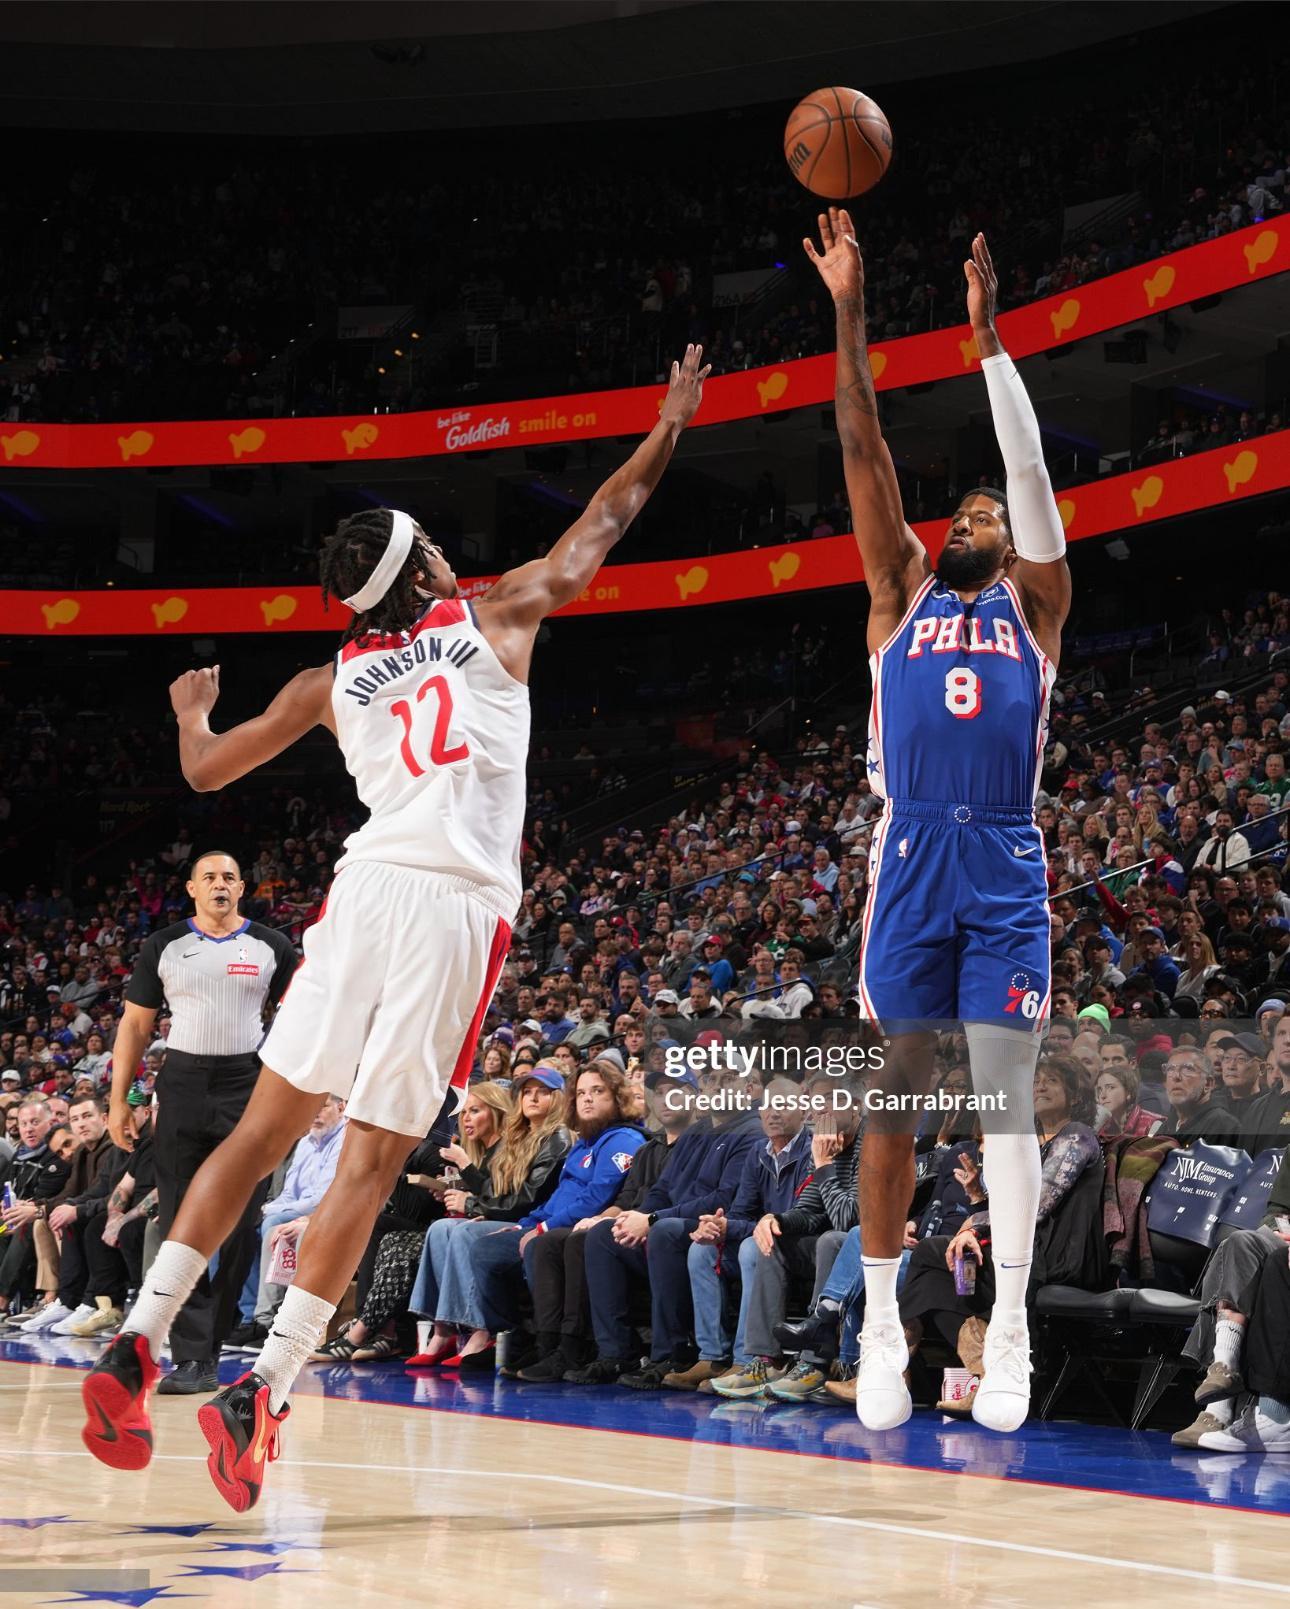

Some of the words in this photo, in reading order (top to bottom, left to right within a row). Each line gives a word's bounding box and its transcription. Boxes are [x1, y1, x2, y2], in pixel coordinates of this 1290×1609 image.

[437, 417, 450, 429] be
[451, 411, 472, 424] like
[519, 410, 568, 433] smile
[572, 412, 597, 427] on
[446, 417, 510, 450] Goldfish
[595, 585, 620, 600] on
[345, 637, 442, 707] JOHNSON
[445, 638, 480, 669] III
[945, 667, 983, 720] 8
[390, 675, 471, 778] 12
[228, 966, 258, 974] Emirates
[1003, 985, 1040, 1019] 76
[1170, 1156, 1206, 1182] NJM
[1200, 1162, 1235, 1180] Insurance
[1198, 1171, 1217, 1186] Group
